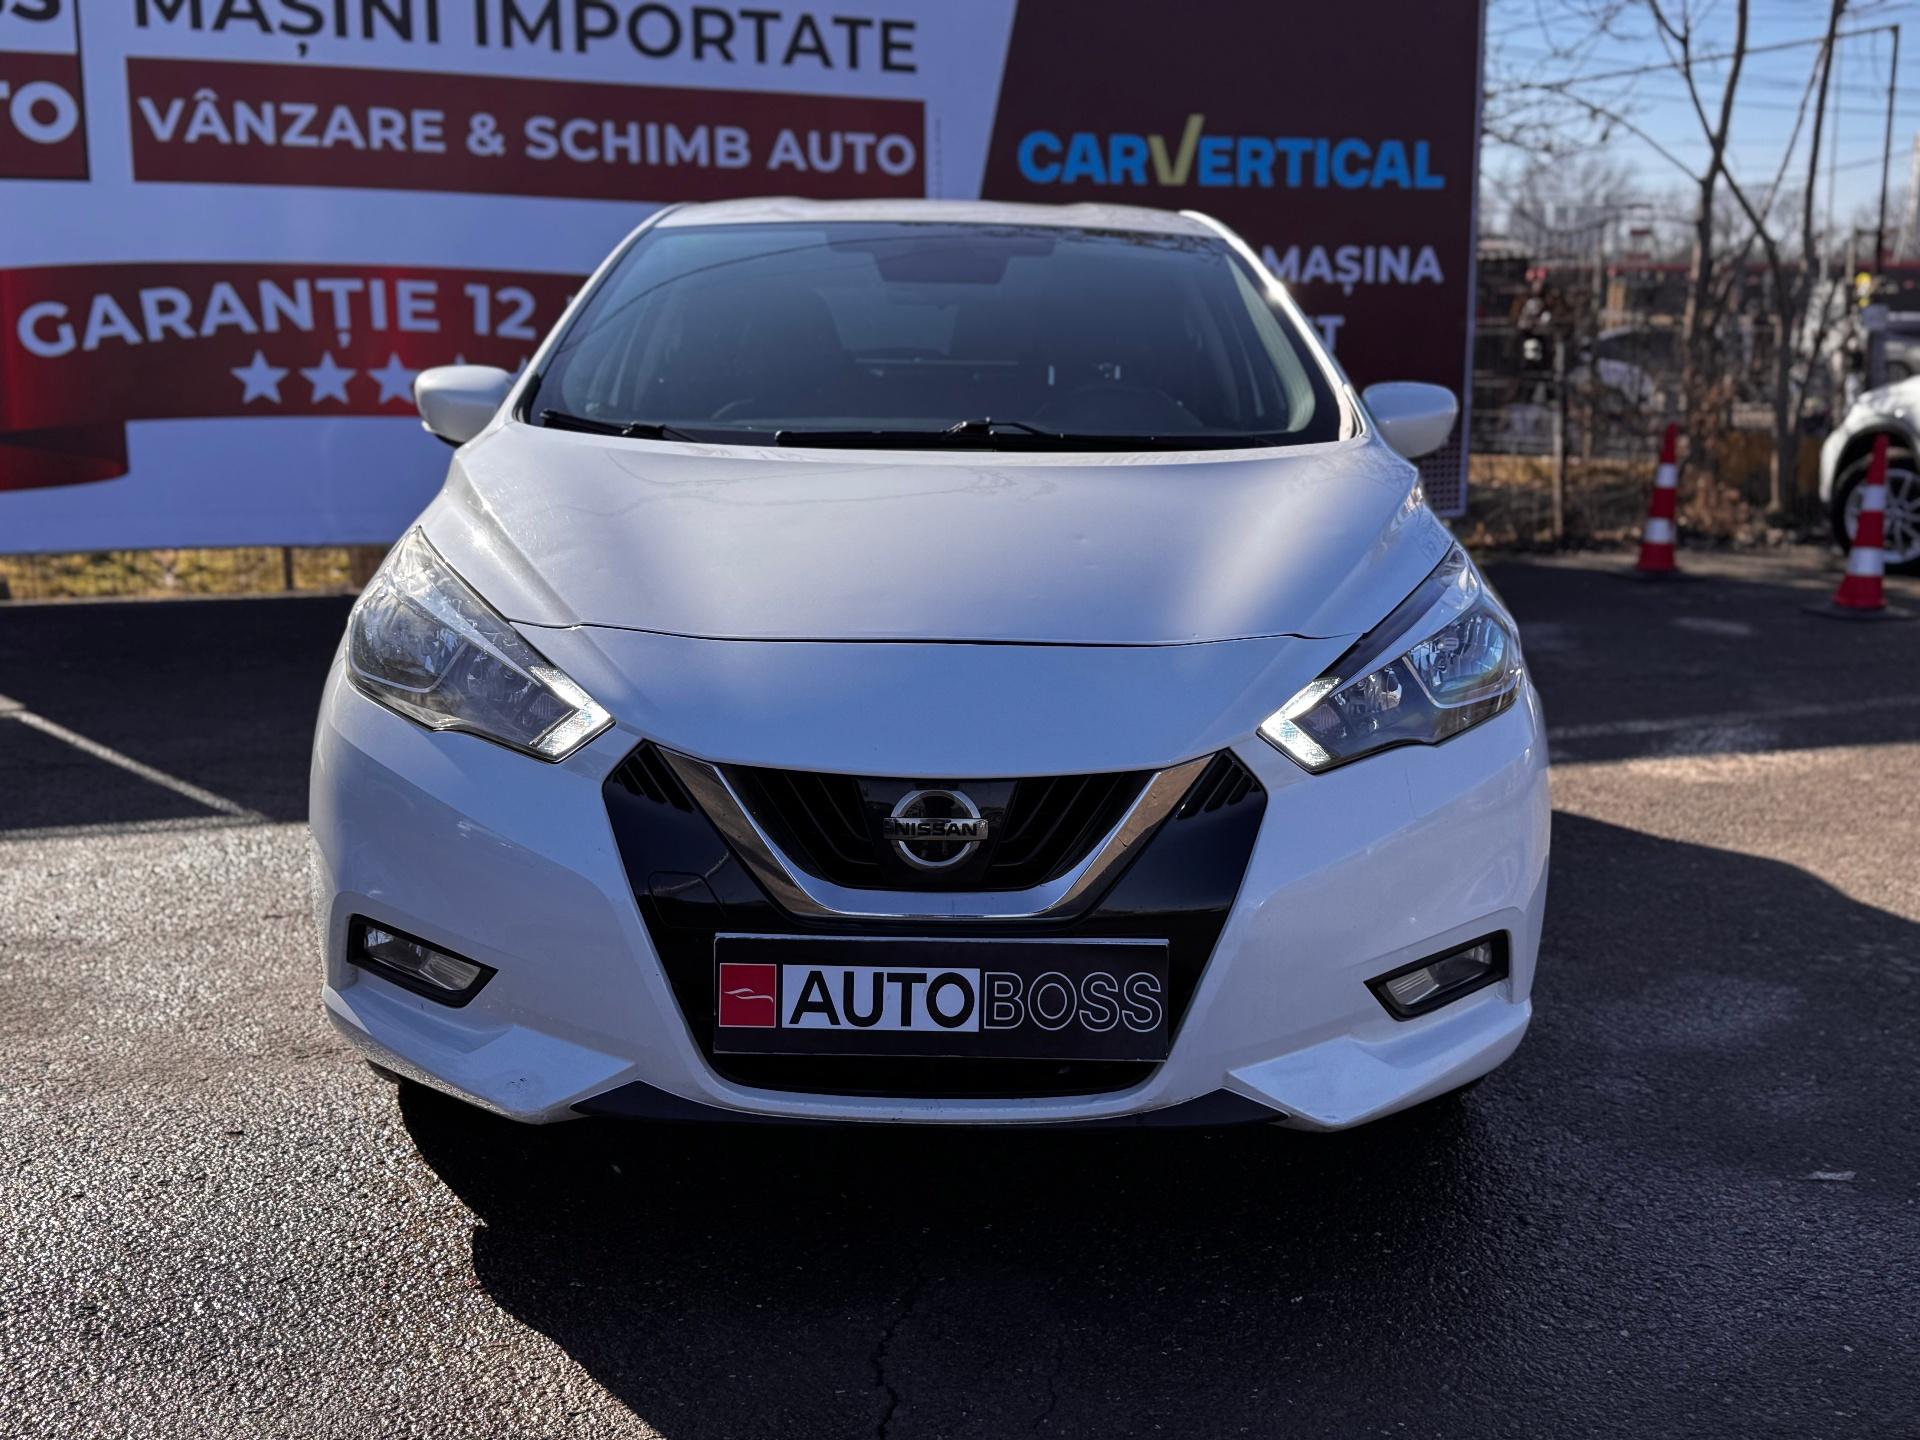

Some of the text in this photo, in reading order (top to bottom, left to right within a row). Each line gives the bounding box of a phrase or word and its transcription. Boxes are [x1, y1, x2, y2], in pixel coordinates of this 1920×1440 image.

[473, 0, 918, 73] IMPORTATE
[138, 89, 446, 153] VÂNZARE
[466, 112, 505, 156] &
[524, 116, 751, 169] SCHIMB
[767, 129, 916, 176] AUTO
[1017, 114, 1446, 189] CARVERTICAL
[1262, 245, 1444, 296] MAȘINA
[17, 278, 537, 357] GARANȚIE 12
[894, 821, 978, 836] NISSAN
